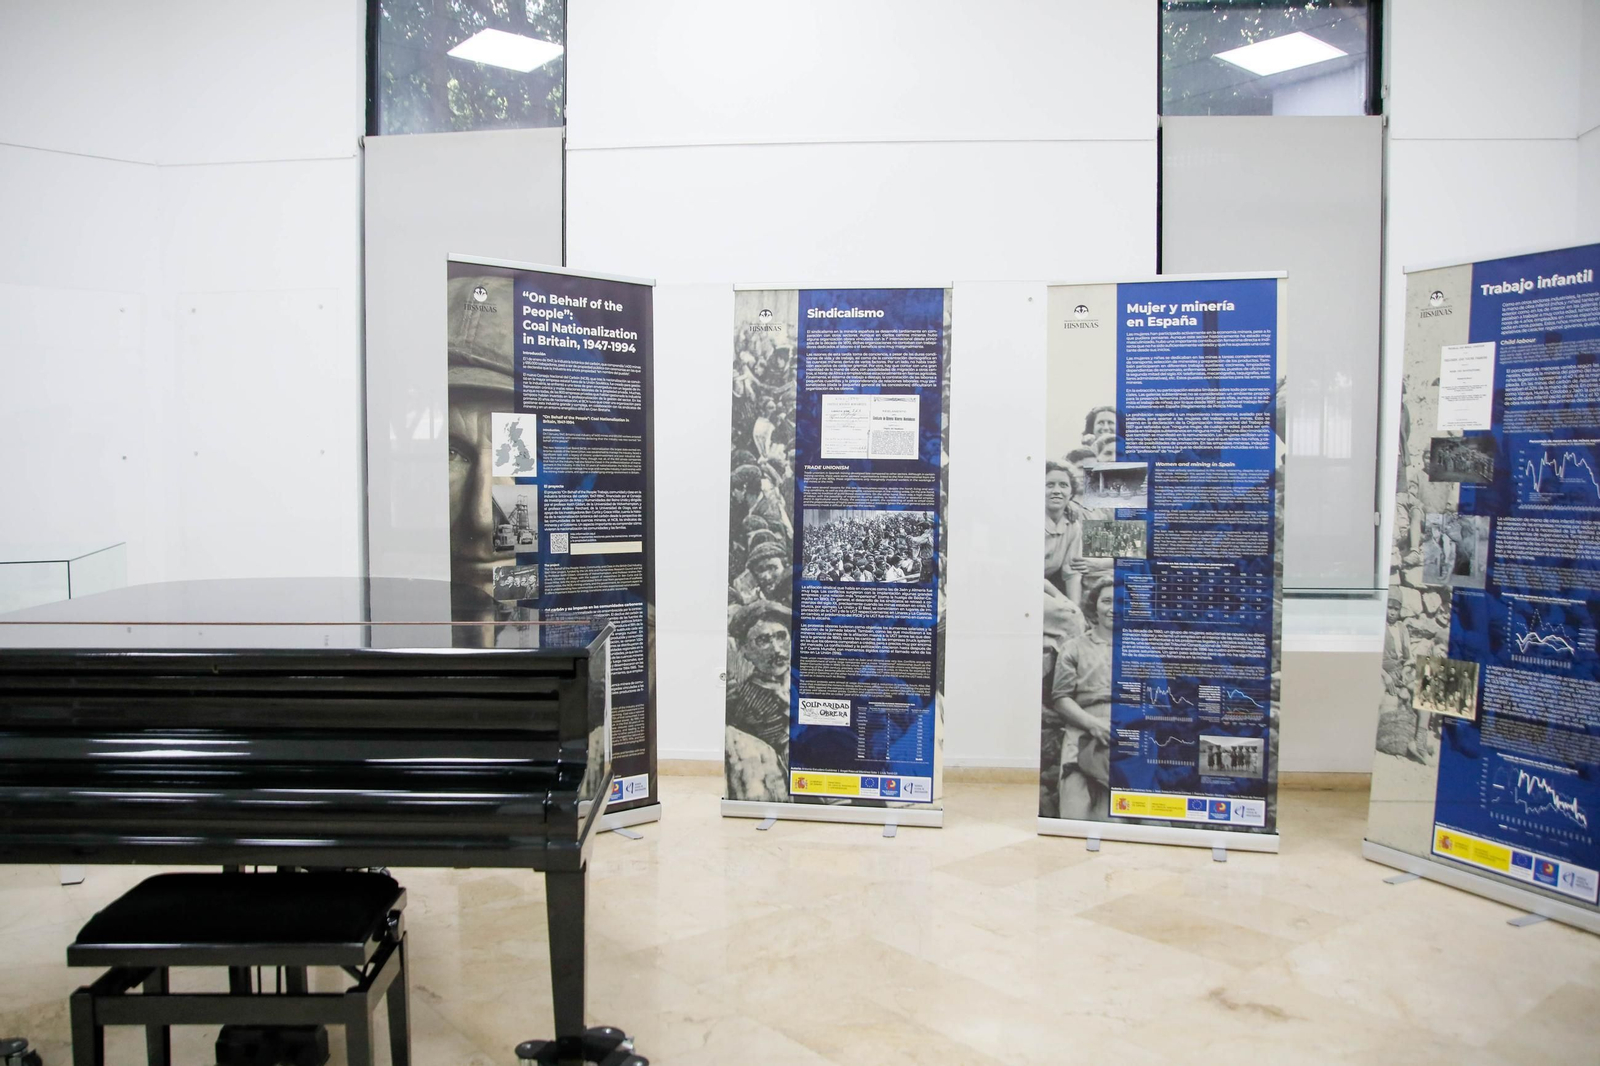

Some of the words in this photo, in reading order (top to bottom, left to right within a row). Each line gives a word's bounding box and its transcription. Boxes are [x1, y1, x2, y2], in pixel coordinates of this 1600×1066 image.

[1481, 278, 1534, 296] Trabajo
[1537, 269, 1593, 289] infantil
[523, 291, 546, 303] “On
[550, 294, 587, 308] Behalf
[590, 299, 602, 310] of
[604, 301, 623, 311] the
[1126, 303, 1166, 315] Mujer
[1170, 306, 1178, 314] y
[1181, 301, 1234, 312] minería
[464, 304, 497, 313] HISMINAS
[523, 306, 573, 320] People”:
[807, 308, 884, 318] Sindicalismo
[1420, 309, 1452, 318] HISMINAS
[1126, 318, 1144, 327] en
[1148, 315, 1197, 328] España
[523, 320, 548, 332] Coal
[552, 322, 637, 340] Nationalization
[523, 333, 534, 344] in
[538, 335, 580, 350] Britain,
[583, 339, 636, 353] 1947-1994
